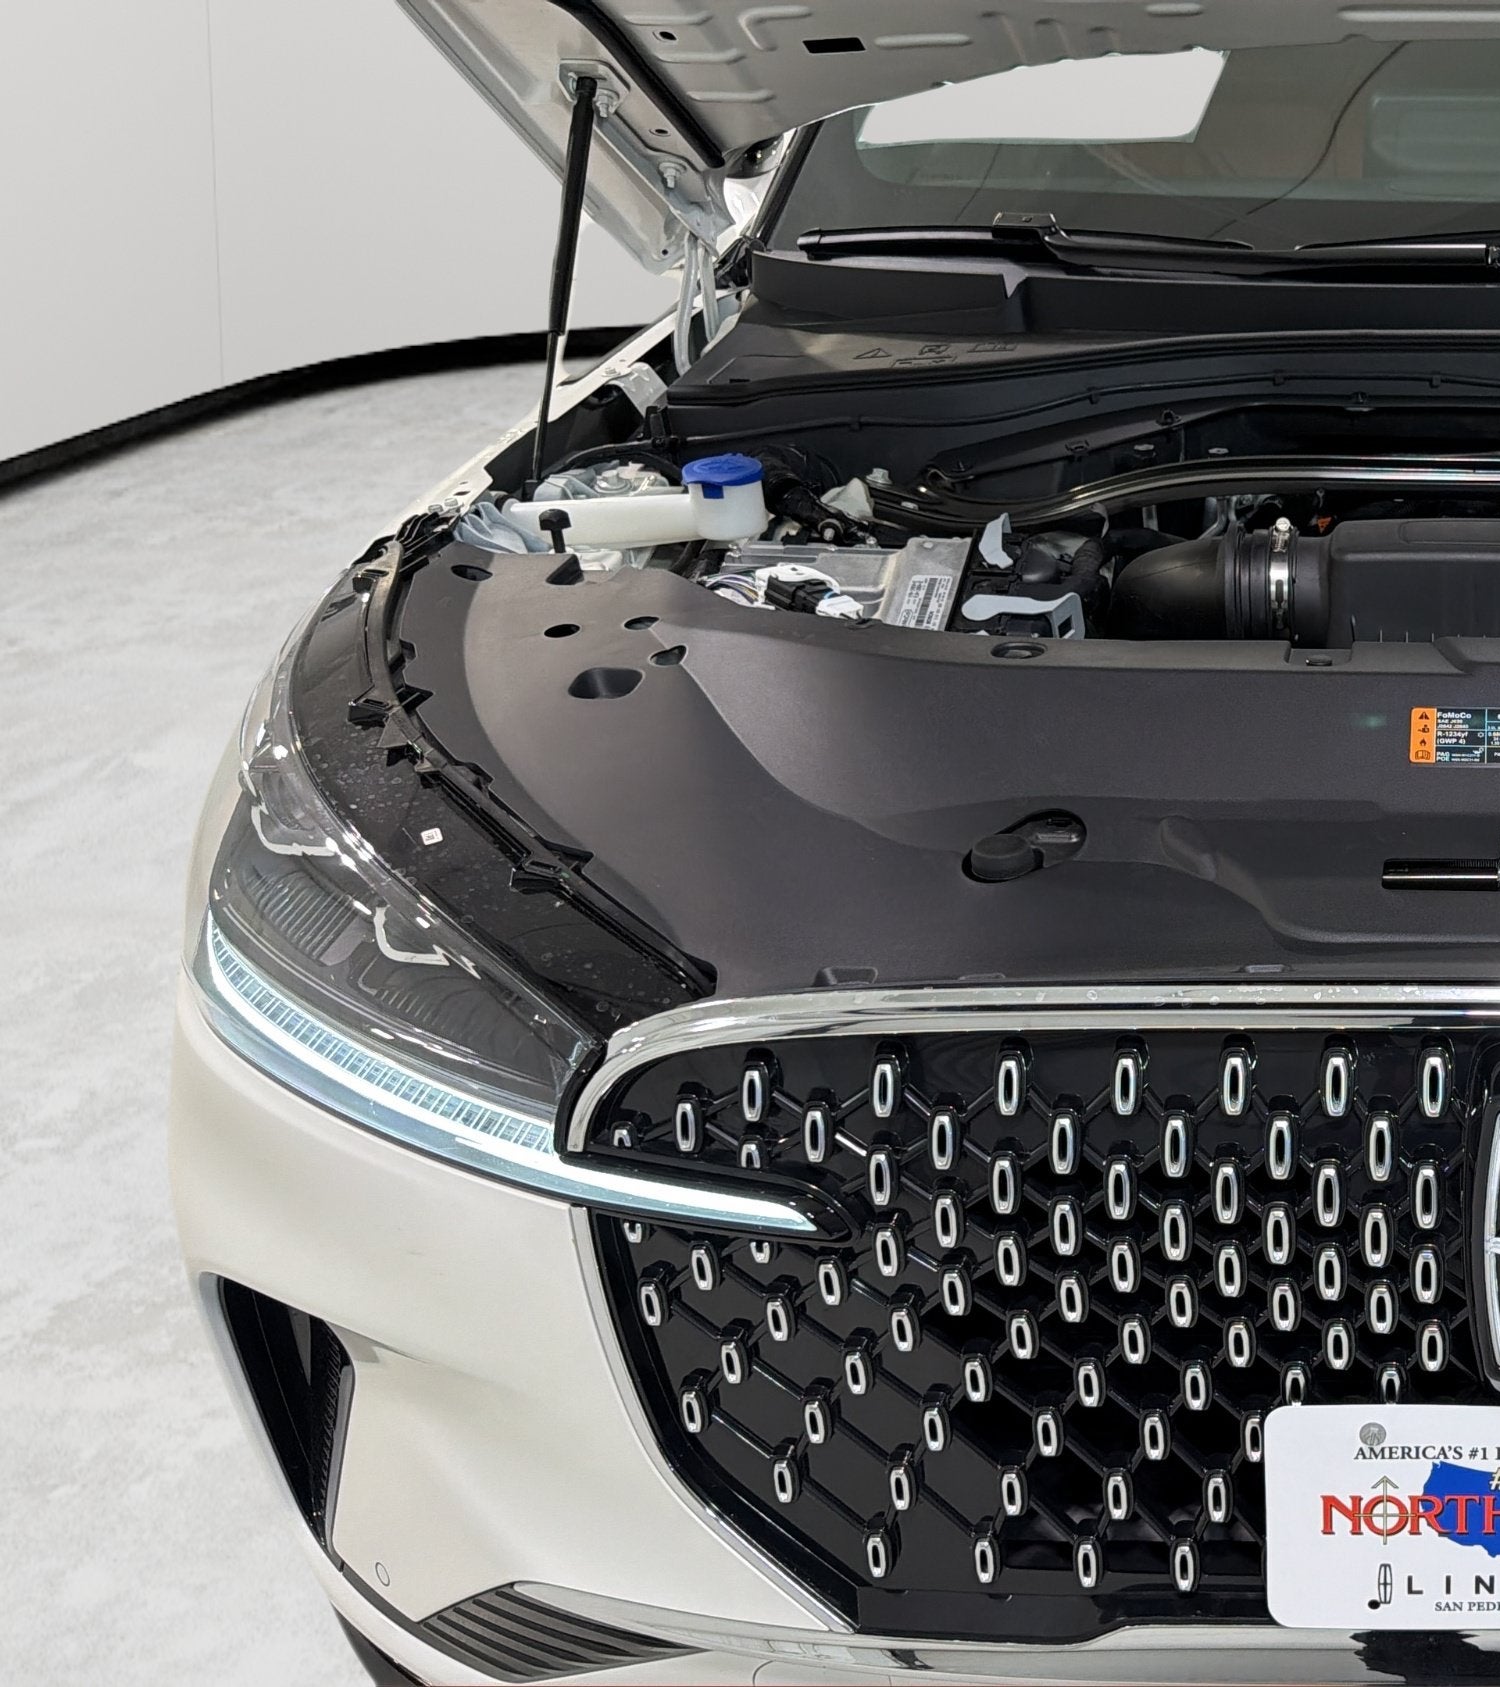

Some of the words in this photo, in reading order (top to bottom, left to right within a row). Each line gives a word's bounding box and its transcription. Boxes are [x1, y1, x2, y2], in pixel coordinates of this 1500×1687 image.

[1353, 1445, 1463, 1461] AMERICA'S
[1468, 1446, 1488, 1461] #1
[1434, 1600, 1464, 1612] SAN
